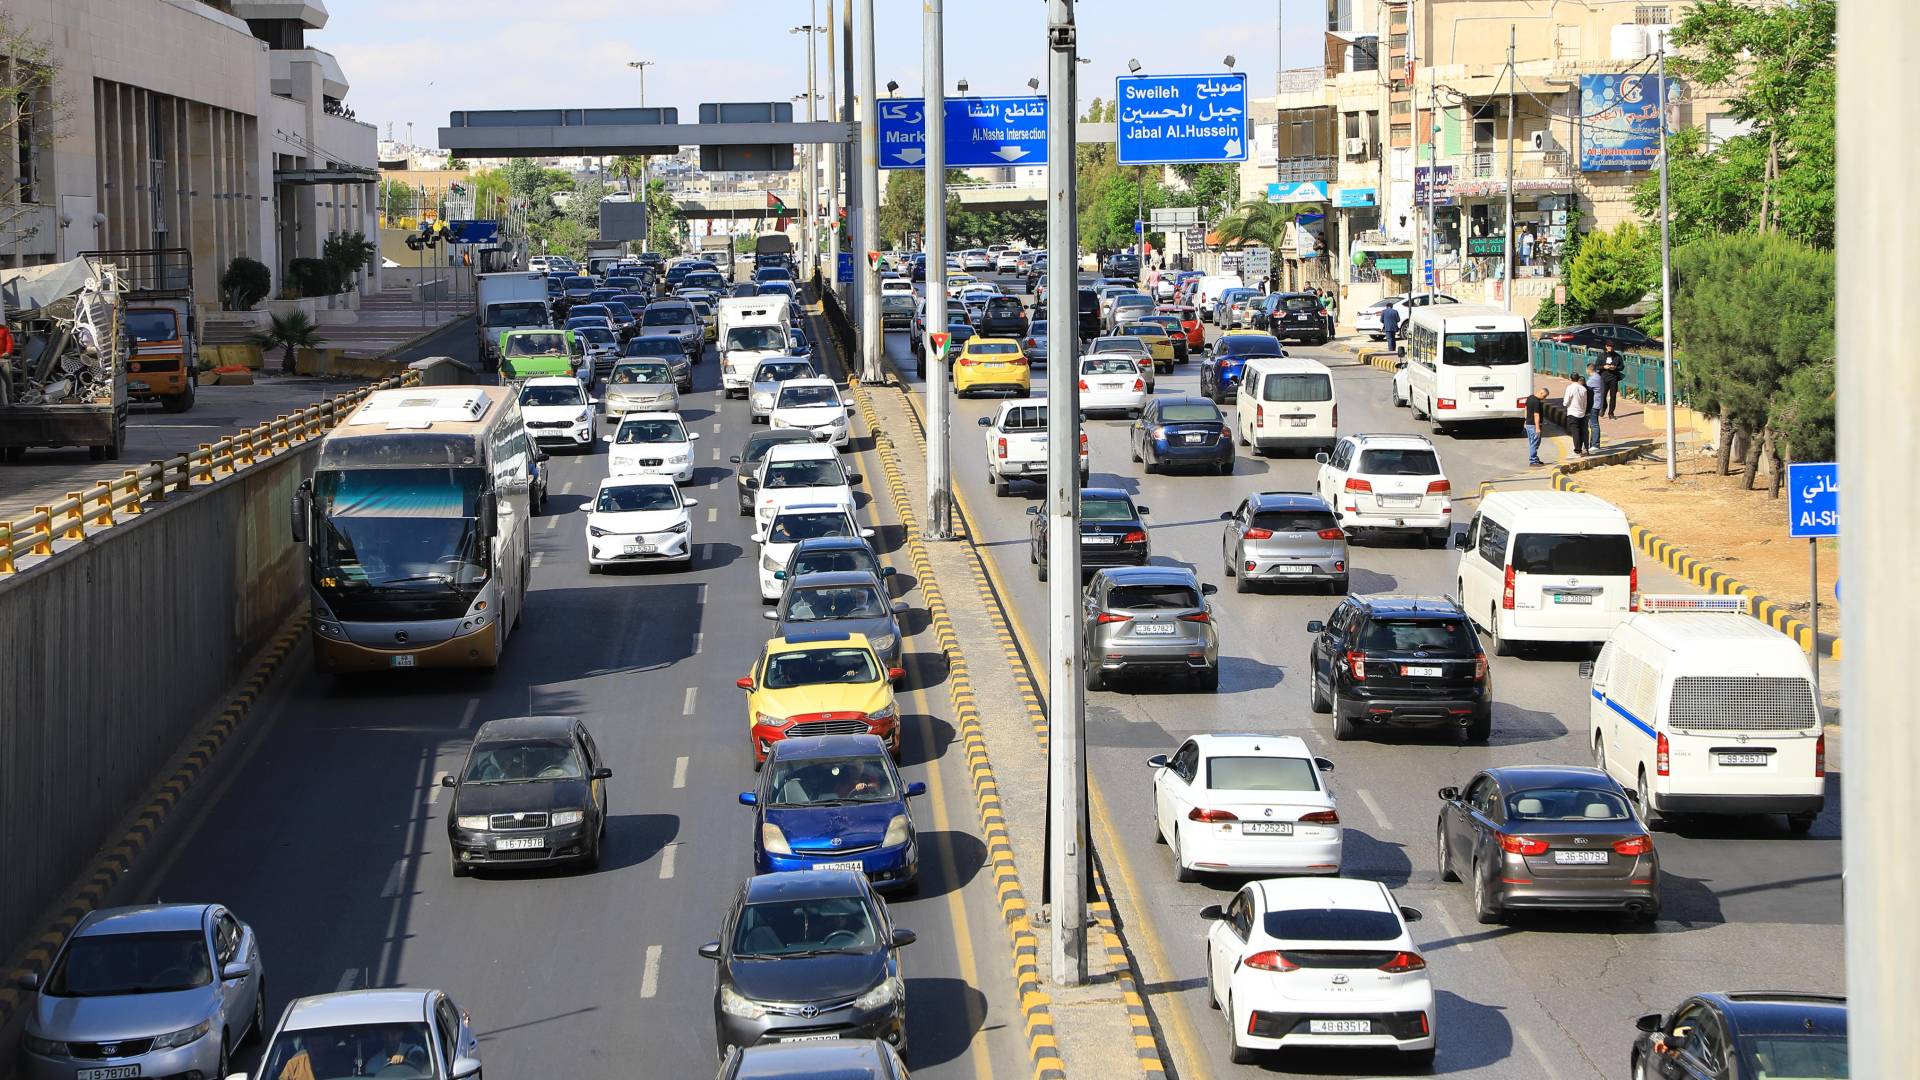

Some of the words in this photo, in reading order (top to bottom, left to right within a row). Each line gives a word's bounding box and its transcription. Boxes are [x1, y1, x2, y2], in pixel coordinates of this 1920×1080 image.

[1126, 85, 1179, 99] Sweileh
[1196, 79, 1242, 99] صويلح
[968, 103, 999, 118] النشا
[1004, 102, 1044, 123] تقاطع
[1122, 103, 1193, 124] الحسين
[1199, 102, 1242, 121] جبل
[886, 130, 925, 143] Mark
[1006, 127, 1046, 140] Intersection
[1127, 125, 1161, 139] Jabal
[1166, 124, 1238, 138] Al.Hussein
[1474, 245, 1503, 253] 04:01
